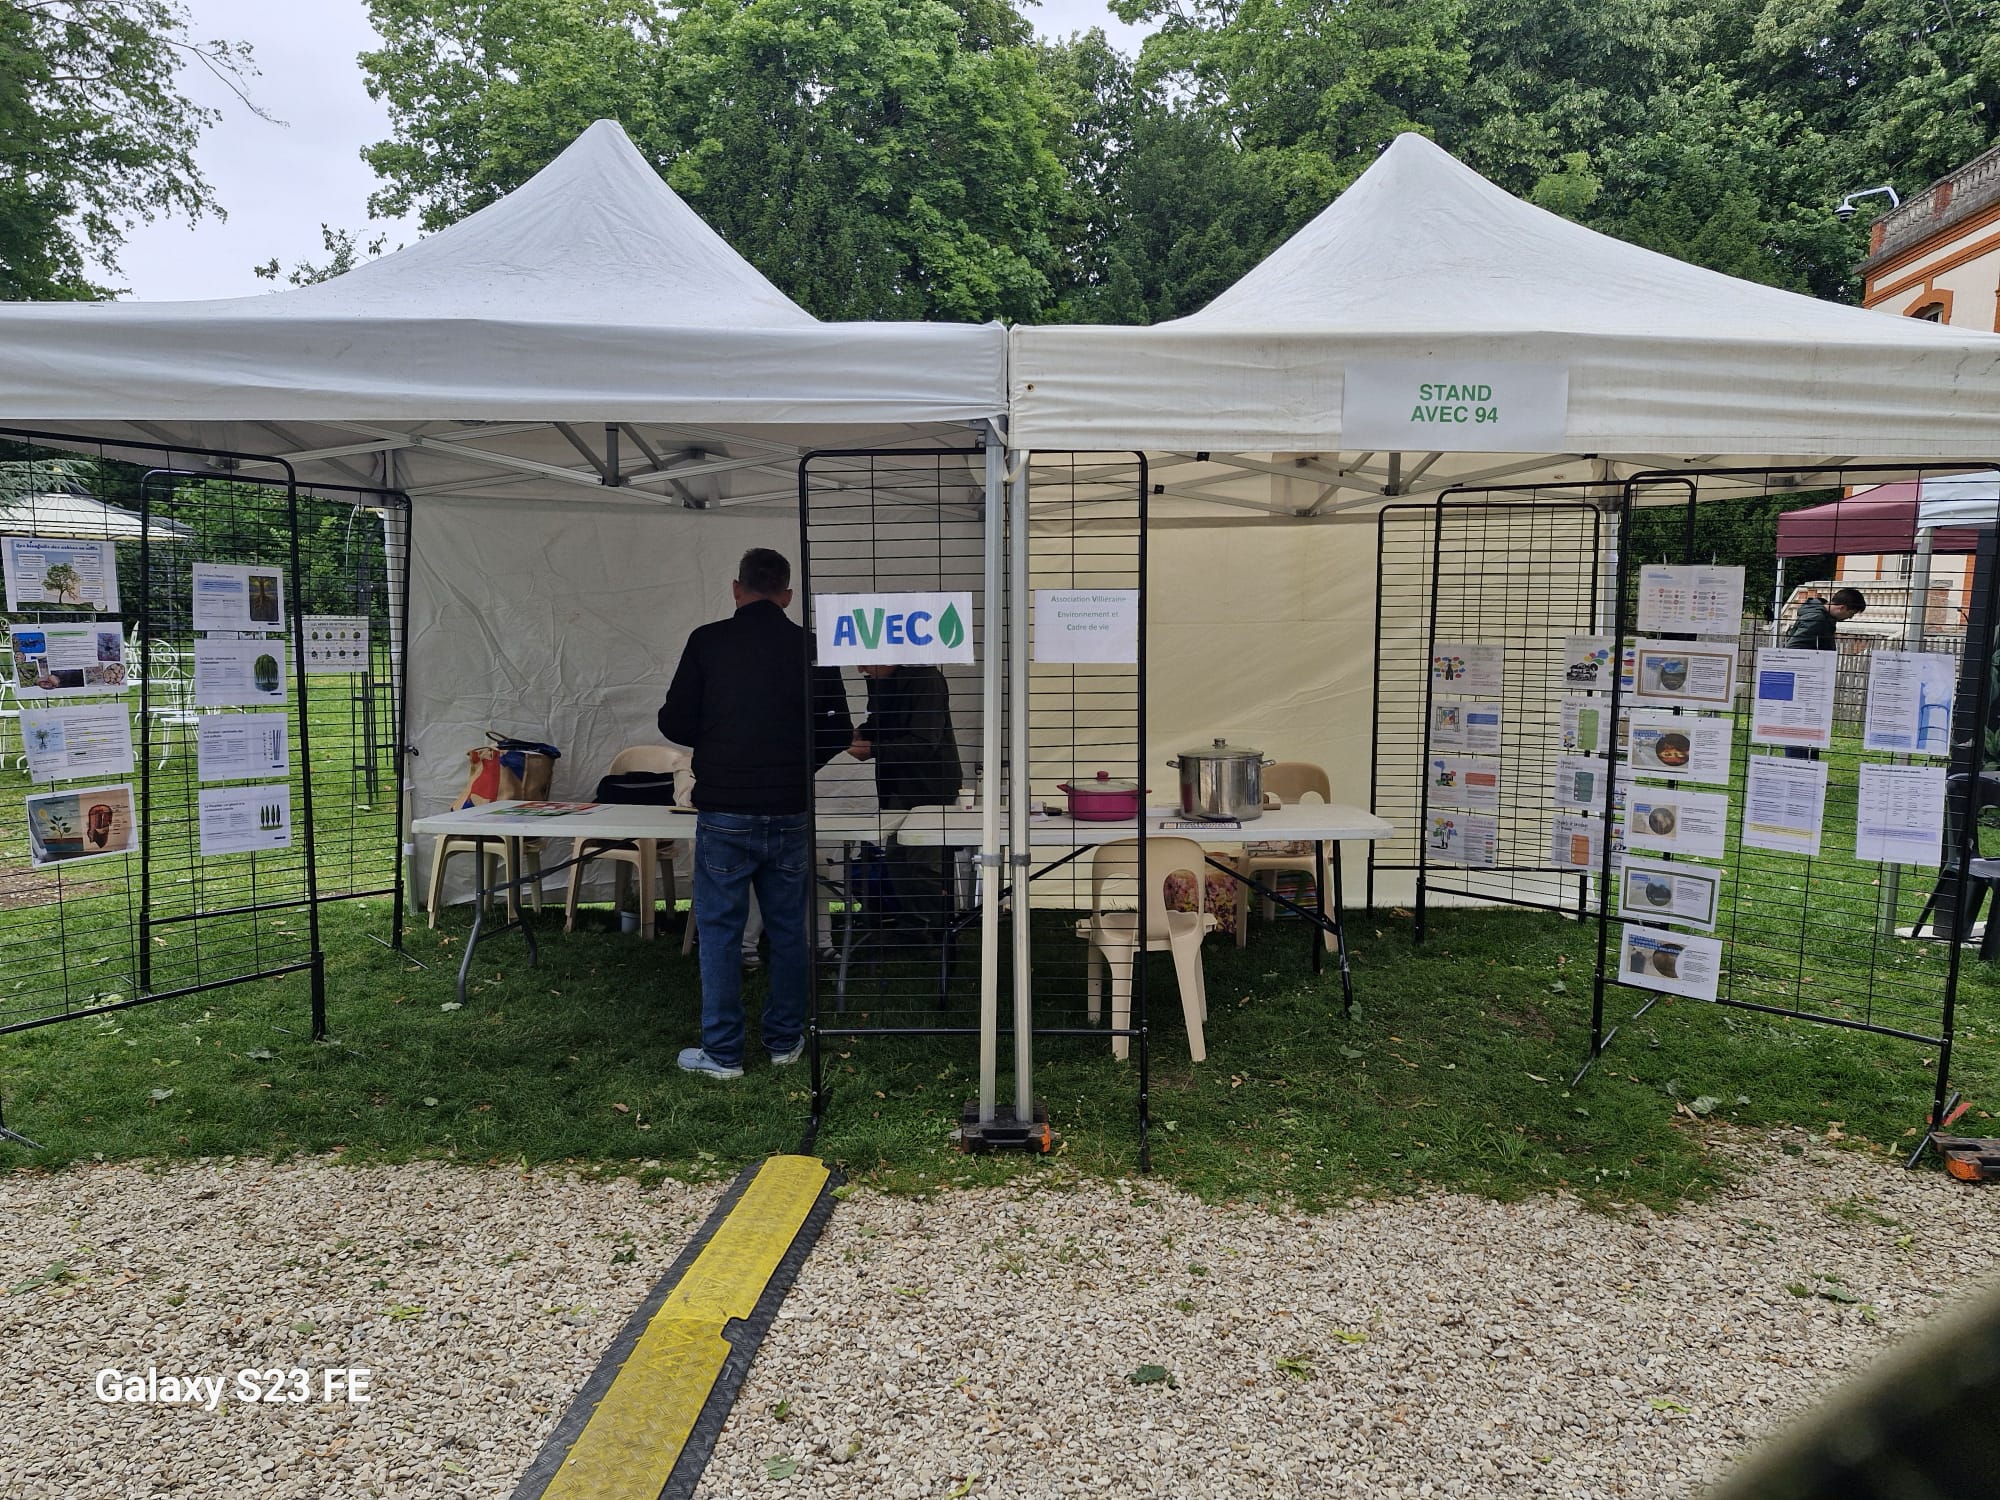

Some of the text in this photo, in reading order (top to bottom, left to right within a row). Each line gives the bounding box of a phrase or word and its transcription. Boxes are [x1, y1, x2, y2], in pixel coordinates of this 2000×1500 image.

[1419, 384, 1492, 401] STAND
[1410, 406, 1498, 423] AVEC 94
[1051, 595, 1090, 603] Association
[833, 607, 933, 650] AVEC
